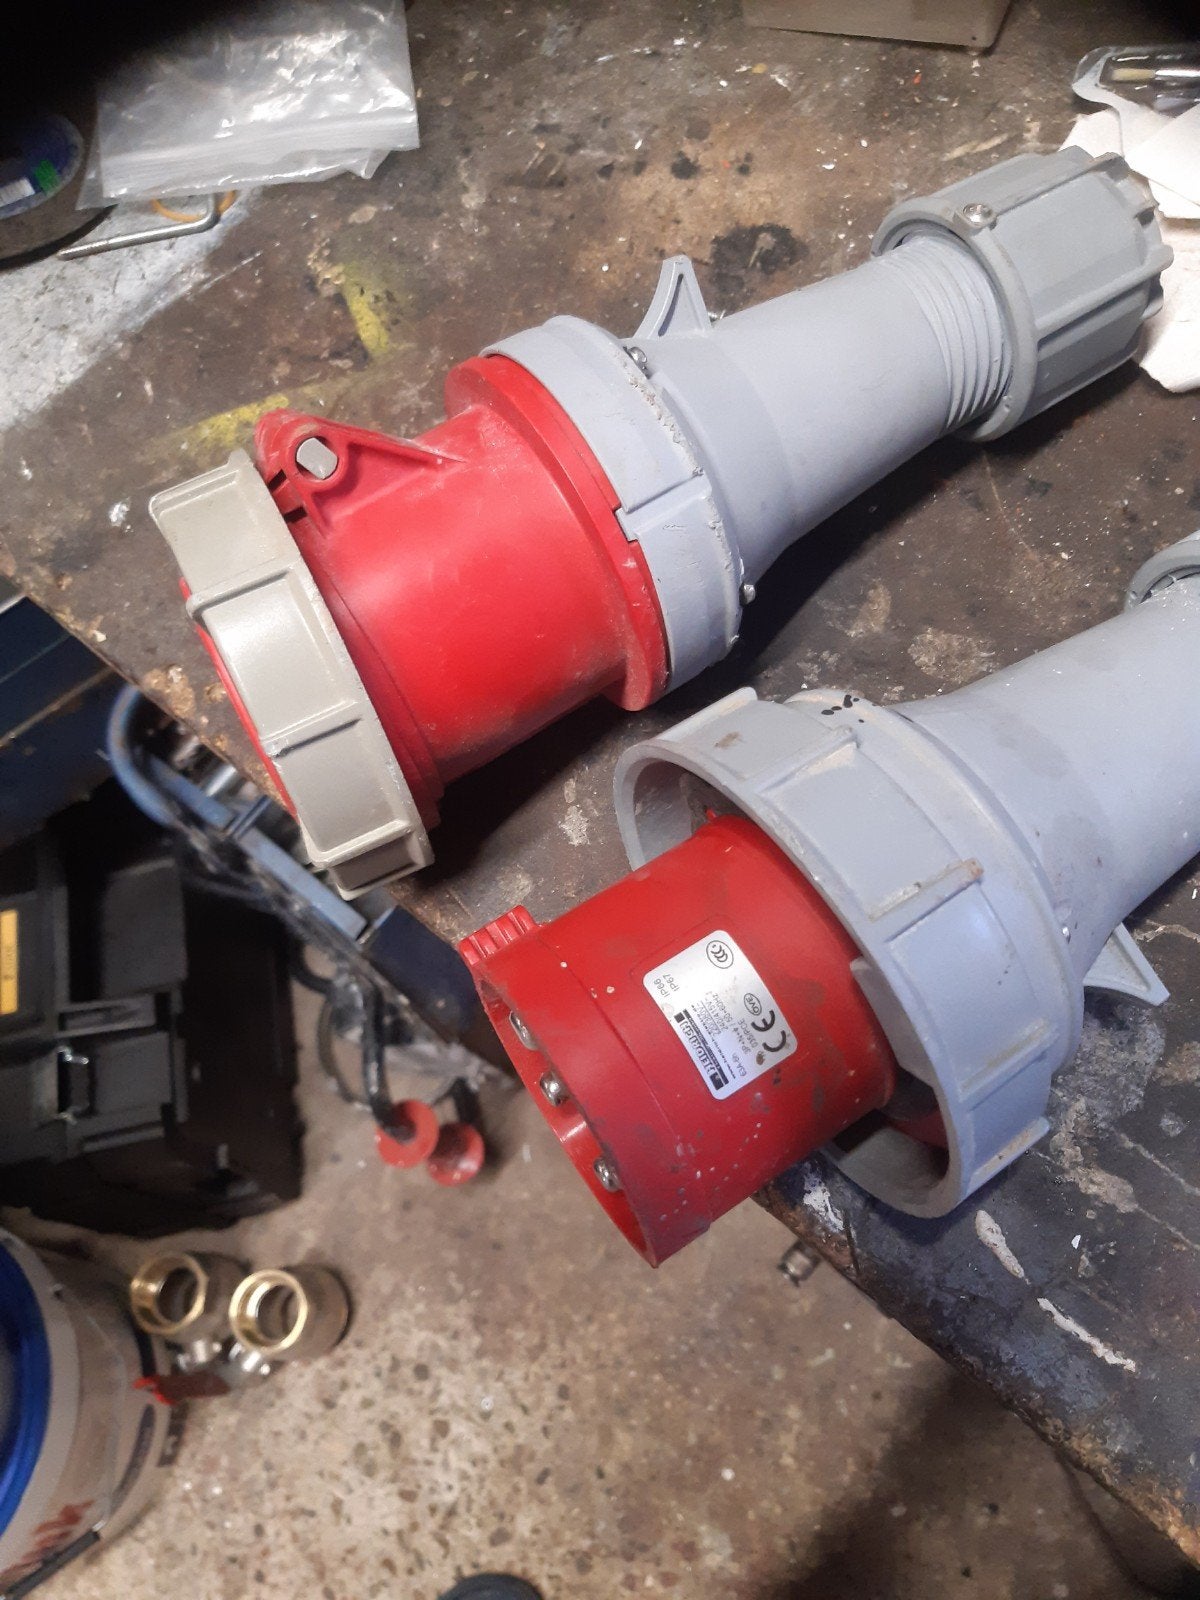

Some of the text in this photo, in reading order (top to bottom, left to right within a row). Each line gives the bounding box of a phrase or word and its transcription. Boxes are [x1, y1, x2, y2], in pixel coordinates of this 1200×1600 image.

[653, 977, 670, 998] IP66
[662, 971, 679, 992] IP67
[678, 1020, 716, 1075] HEIDRICH
